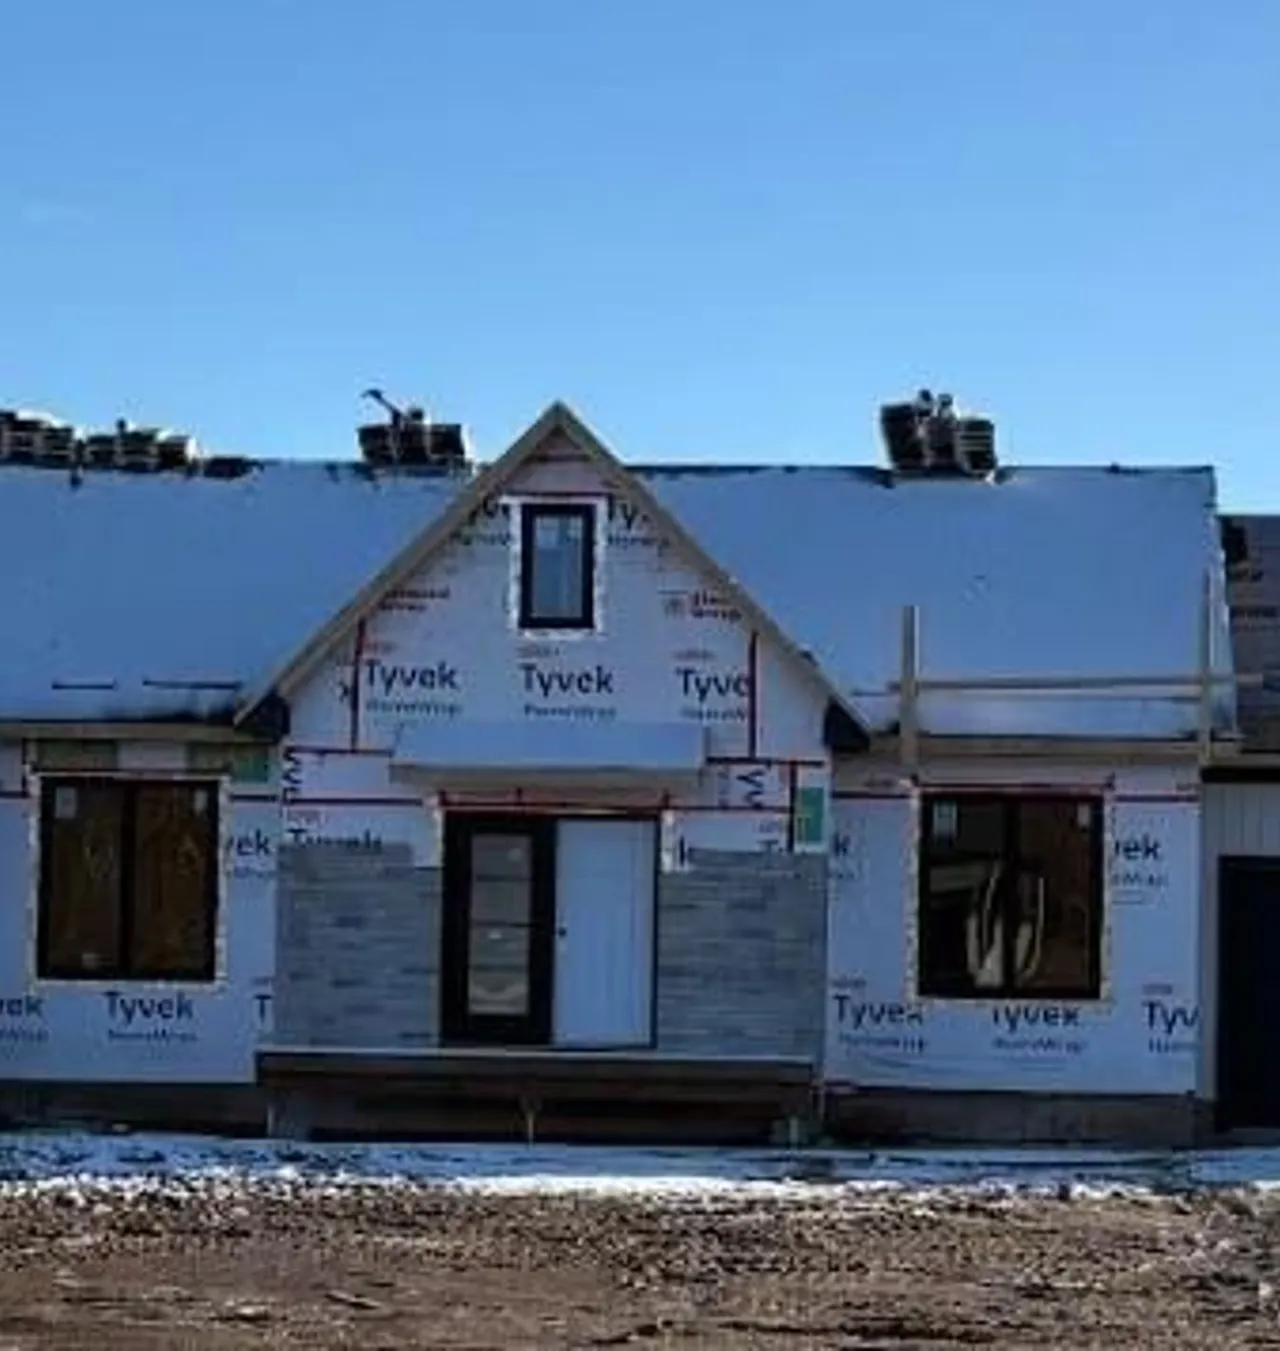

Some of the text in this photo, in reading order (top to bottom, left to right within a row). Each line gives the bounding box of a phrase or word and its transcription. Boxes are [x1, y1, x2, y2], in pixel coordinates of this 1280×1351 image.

[365, 659, 460, 697] Tyvek
[519, 663, 614, 697] Tyvek
[105, 992, 194, 1026] Tyvek
